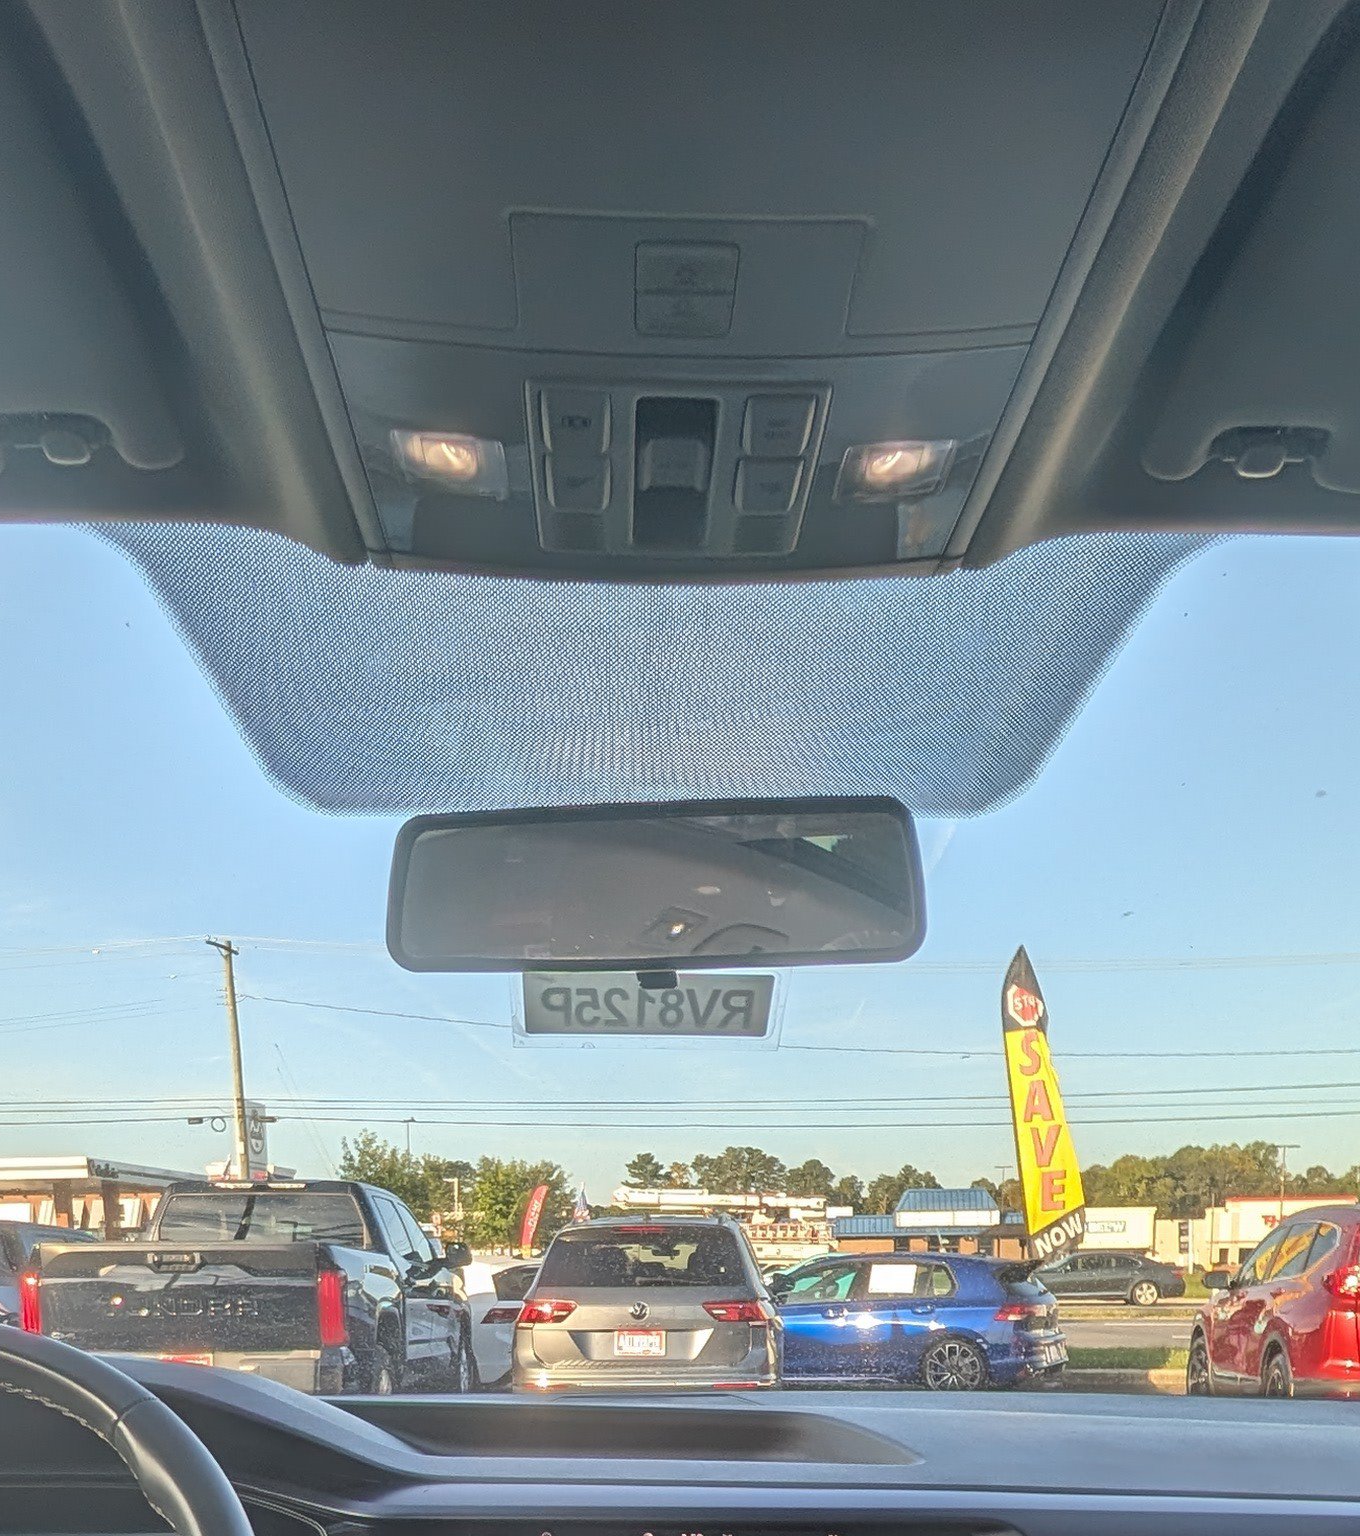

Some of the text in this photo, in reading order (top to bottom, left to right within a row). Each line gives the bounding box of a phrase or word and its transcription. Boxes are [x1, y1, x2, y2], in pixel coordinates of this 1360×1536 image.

[1013, 993, 1037, 1011] STO
[1019, 1029, 1066, 1212] SAVE
[1034, 1212, 1085, 1259] NOW
